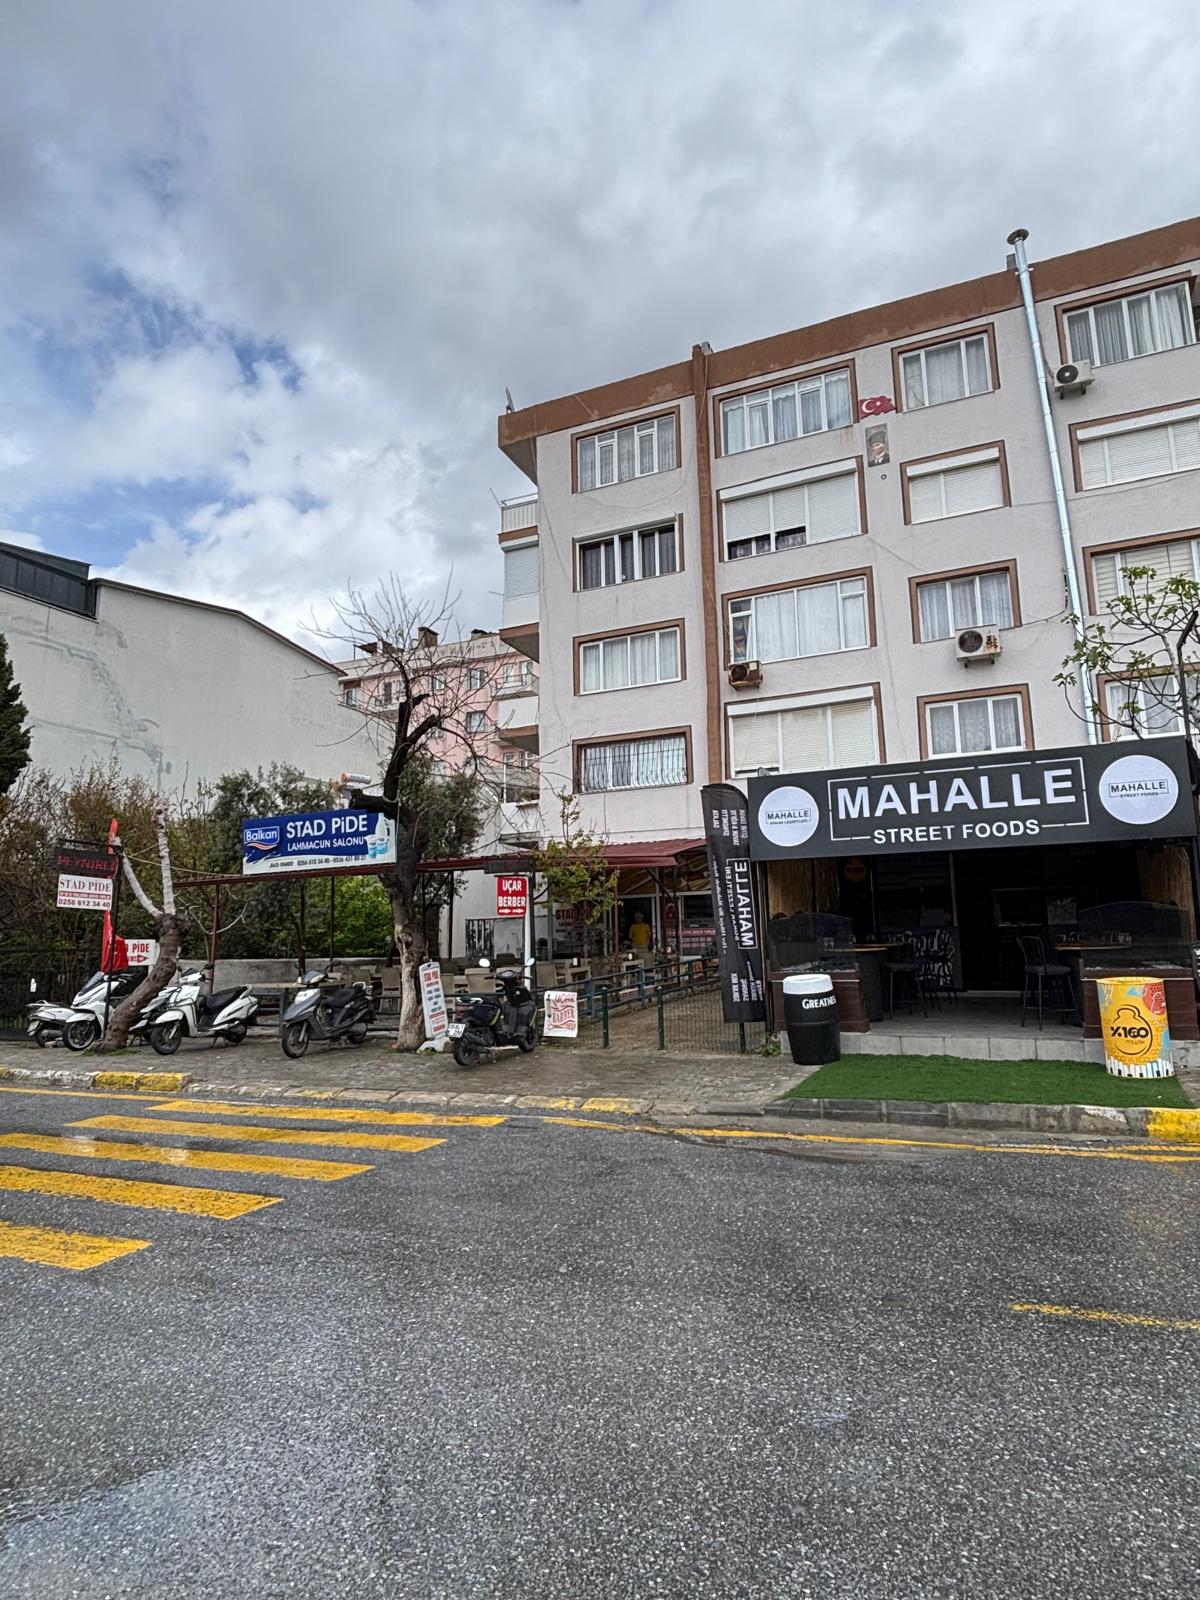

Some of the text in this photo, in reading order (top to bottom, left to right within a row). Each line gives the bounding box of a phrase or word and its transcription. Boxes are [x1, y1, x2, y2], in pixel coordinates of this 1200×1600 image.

[1110, 781, 1167, 793] MAHALLE
[837, 768, 1076, 820] MAHALLE
[767, 810, 809, 820] MAHALLE
[245, 829, 278, 841] Balkan
[286, 820, 326, 839] STAD
[873, 819, 1040, 845] STREET FOODS
[287, 836, 364, 851] LAHMACUN SALONU
[59, 879, 85, 890] STAD
[502, 880, 522, 894] UÇAR
[498, 896, 526, 907] BERBER
